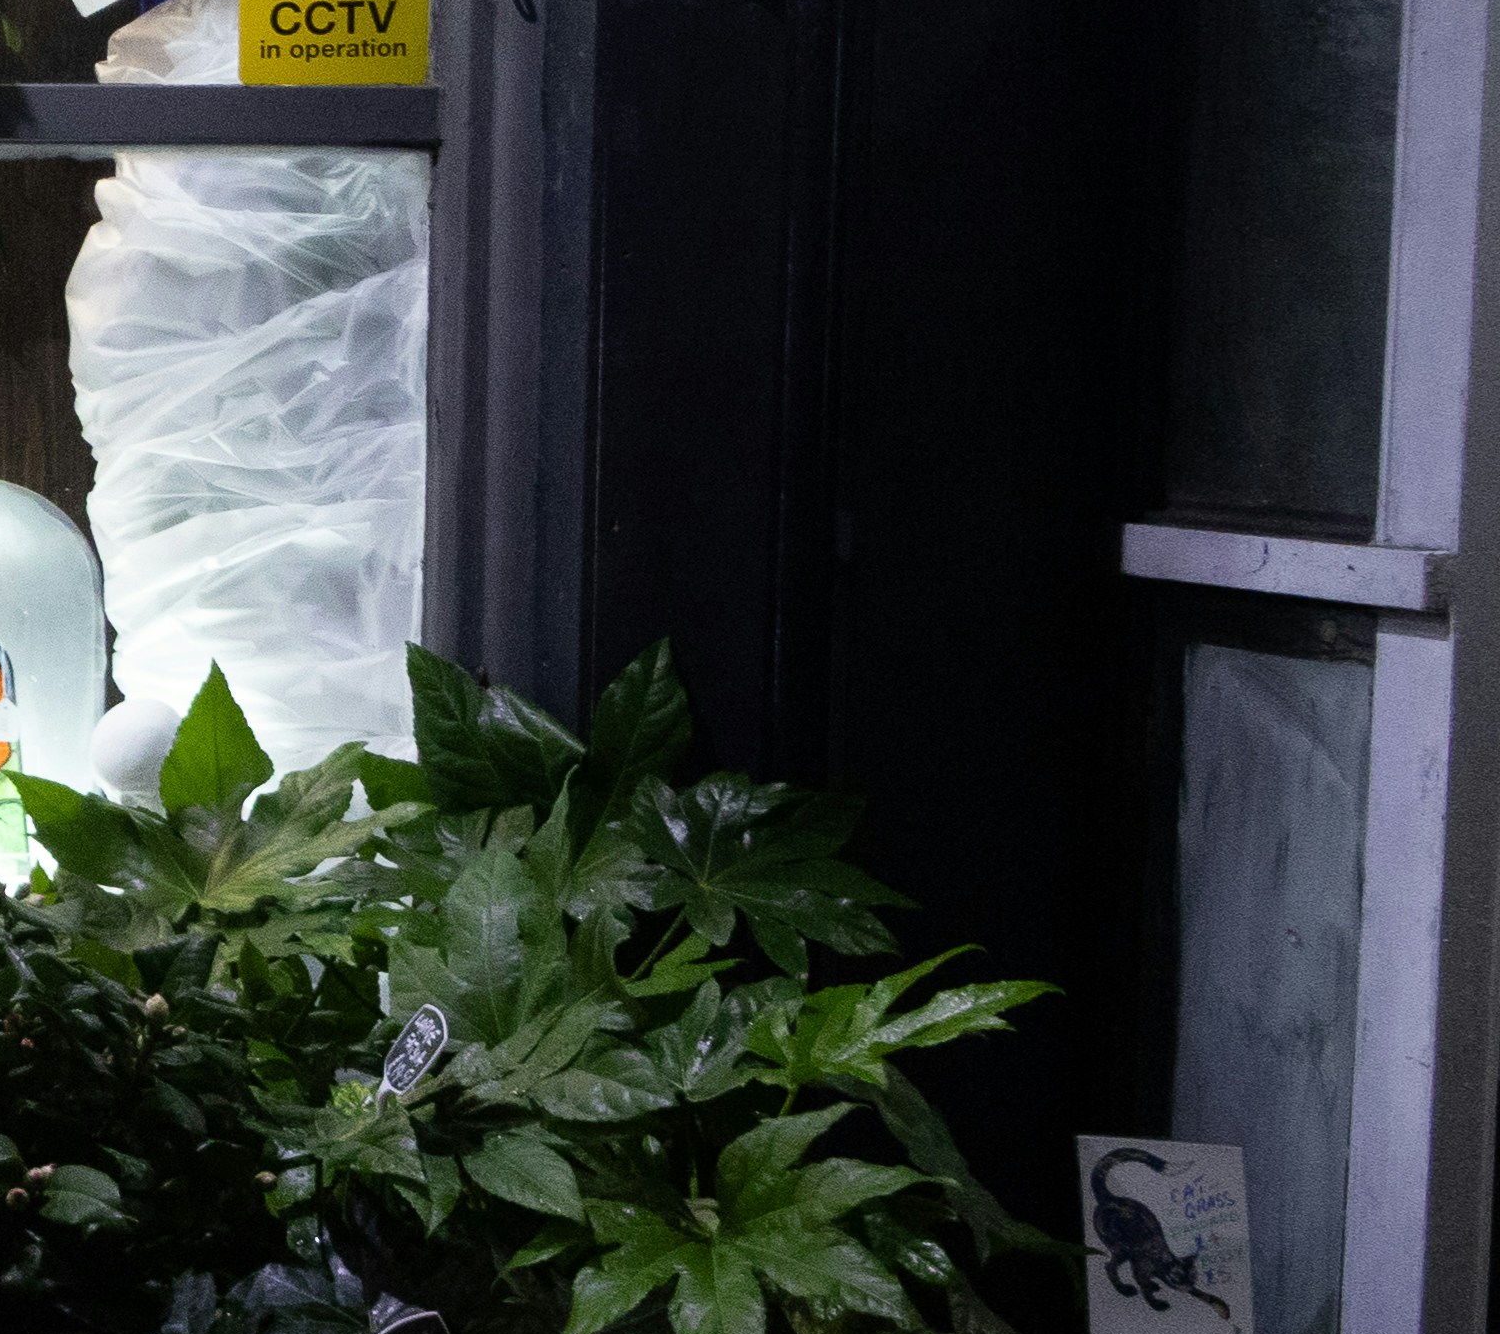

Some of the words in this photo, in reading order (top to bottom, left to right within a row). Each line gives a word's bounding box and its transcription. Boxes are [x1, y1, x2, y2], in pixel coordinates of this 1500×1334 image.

[269, 0, 398, 36] CCTV
[260, 40, 281, 59] in
[289, 39, 408, 63] operation
